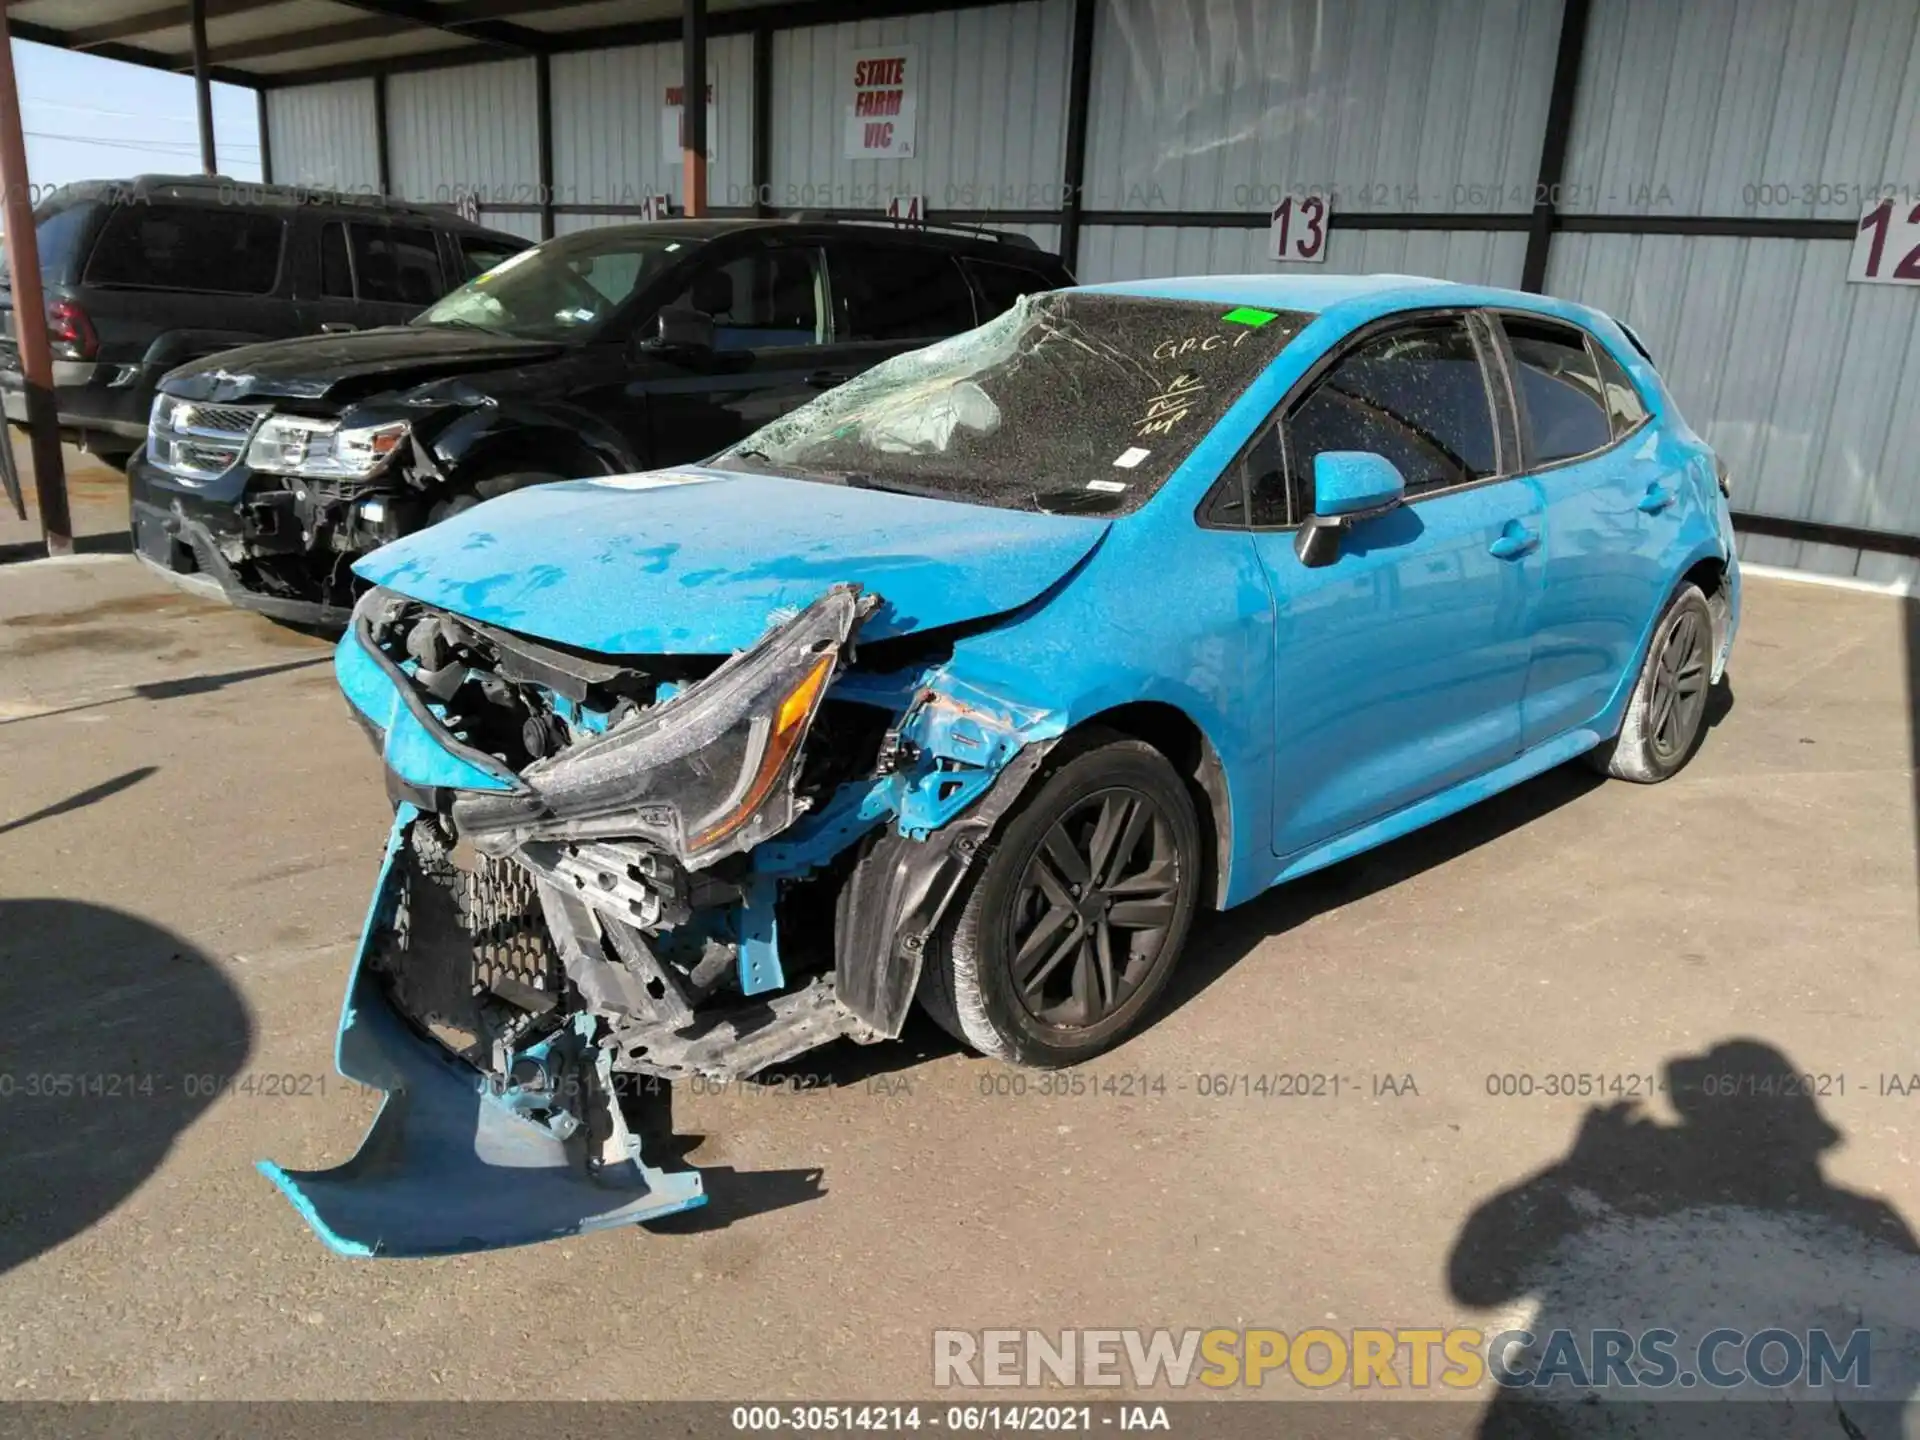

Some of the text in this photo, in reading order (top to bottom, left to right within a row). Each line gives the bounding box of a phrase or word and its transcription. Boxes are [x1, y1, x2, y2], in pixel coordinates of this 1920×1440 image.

[854, 58, 907, 88] STATE
[855, 90, 903, 117] FARM
[864, 122, 894, 149] VIC
[1274, 197, 1324, 258] 13
